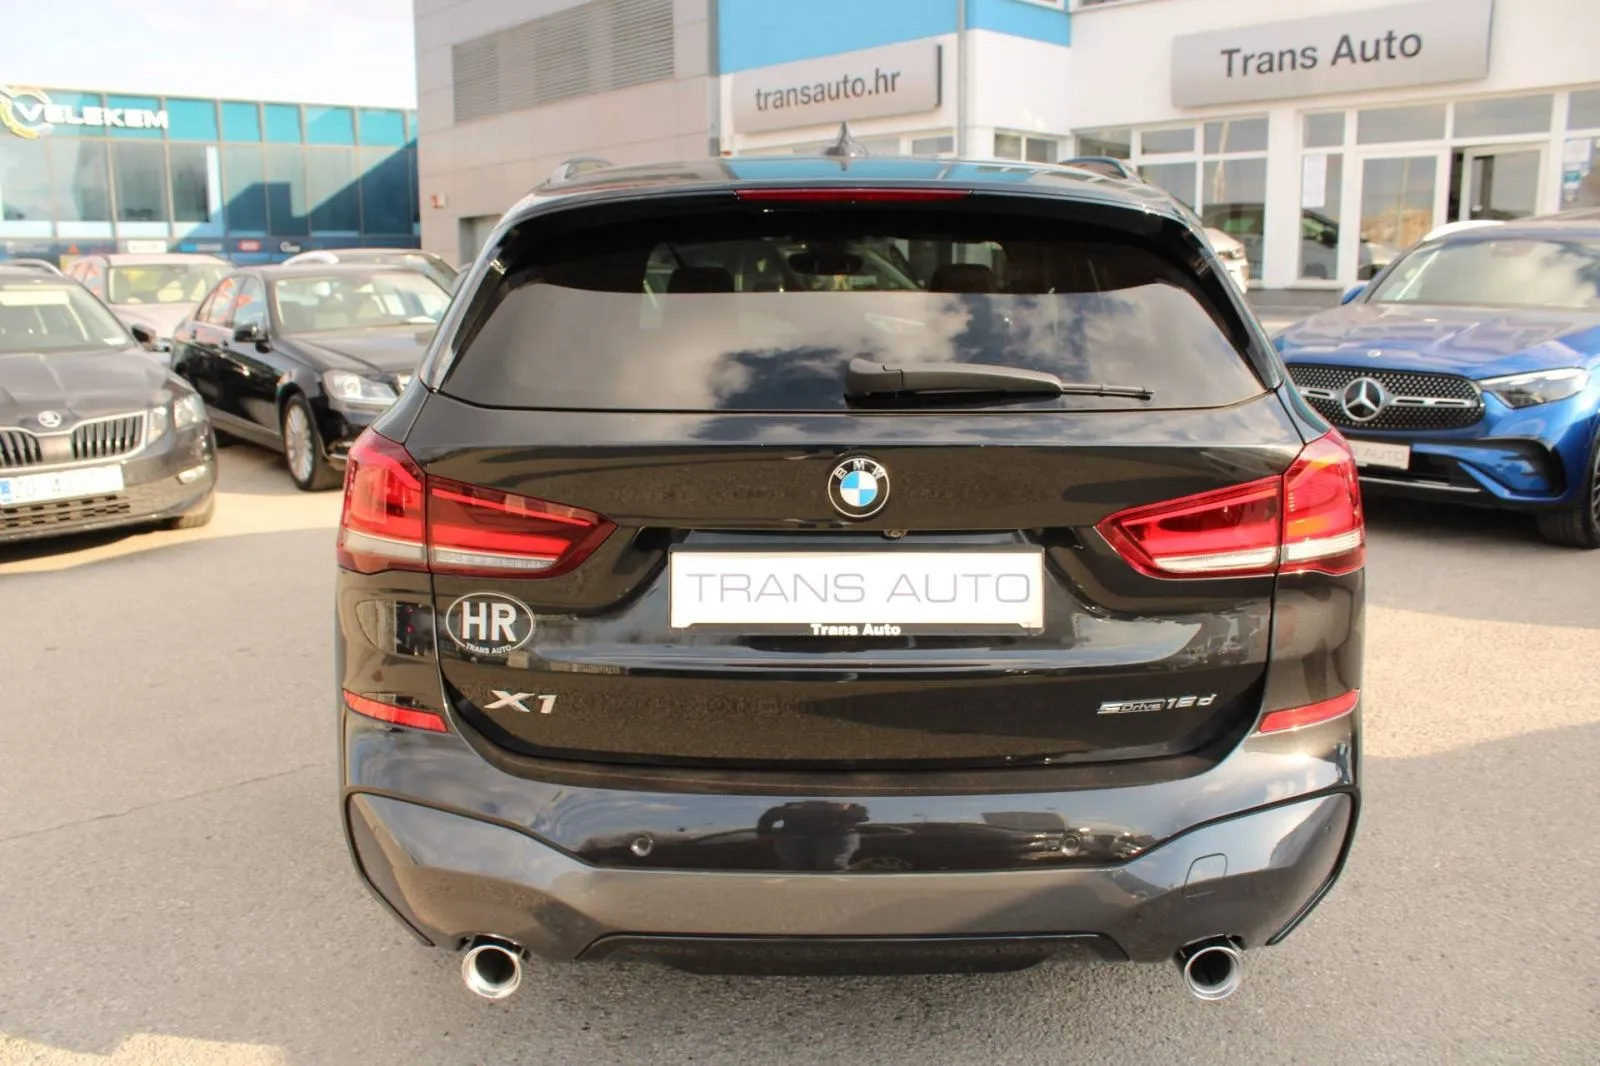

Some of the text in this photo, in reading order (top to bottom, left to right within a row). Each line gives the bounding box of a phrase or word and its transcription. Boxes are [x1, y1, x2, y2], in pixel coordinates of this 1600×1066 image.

[1220, 30, 1422, 78] Trans Auto
[755, 67, 901, 112] transauto.hr
[13, 100, 169, 129] VELEKEM
[834, 459, 886, 480] BMW
[686, 573, 1031, 603] TRANS AUTO
[462, 601, 517, 642] HR
[810, 622, 901, 636] Trans Auto
[464, 642, 512, 655] TRANS AUTO
[483, 689, 557, 714] X1
